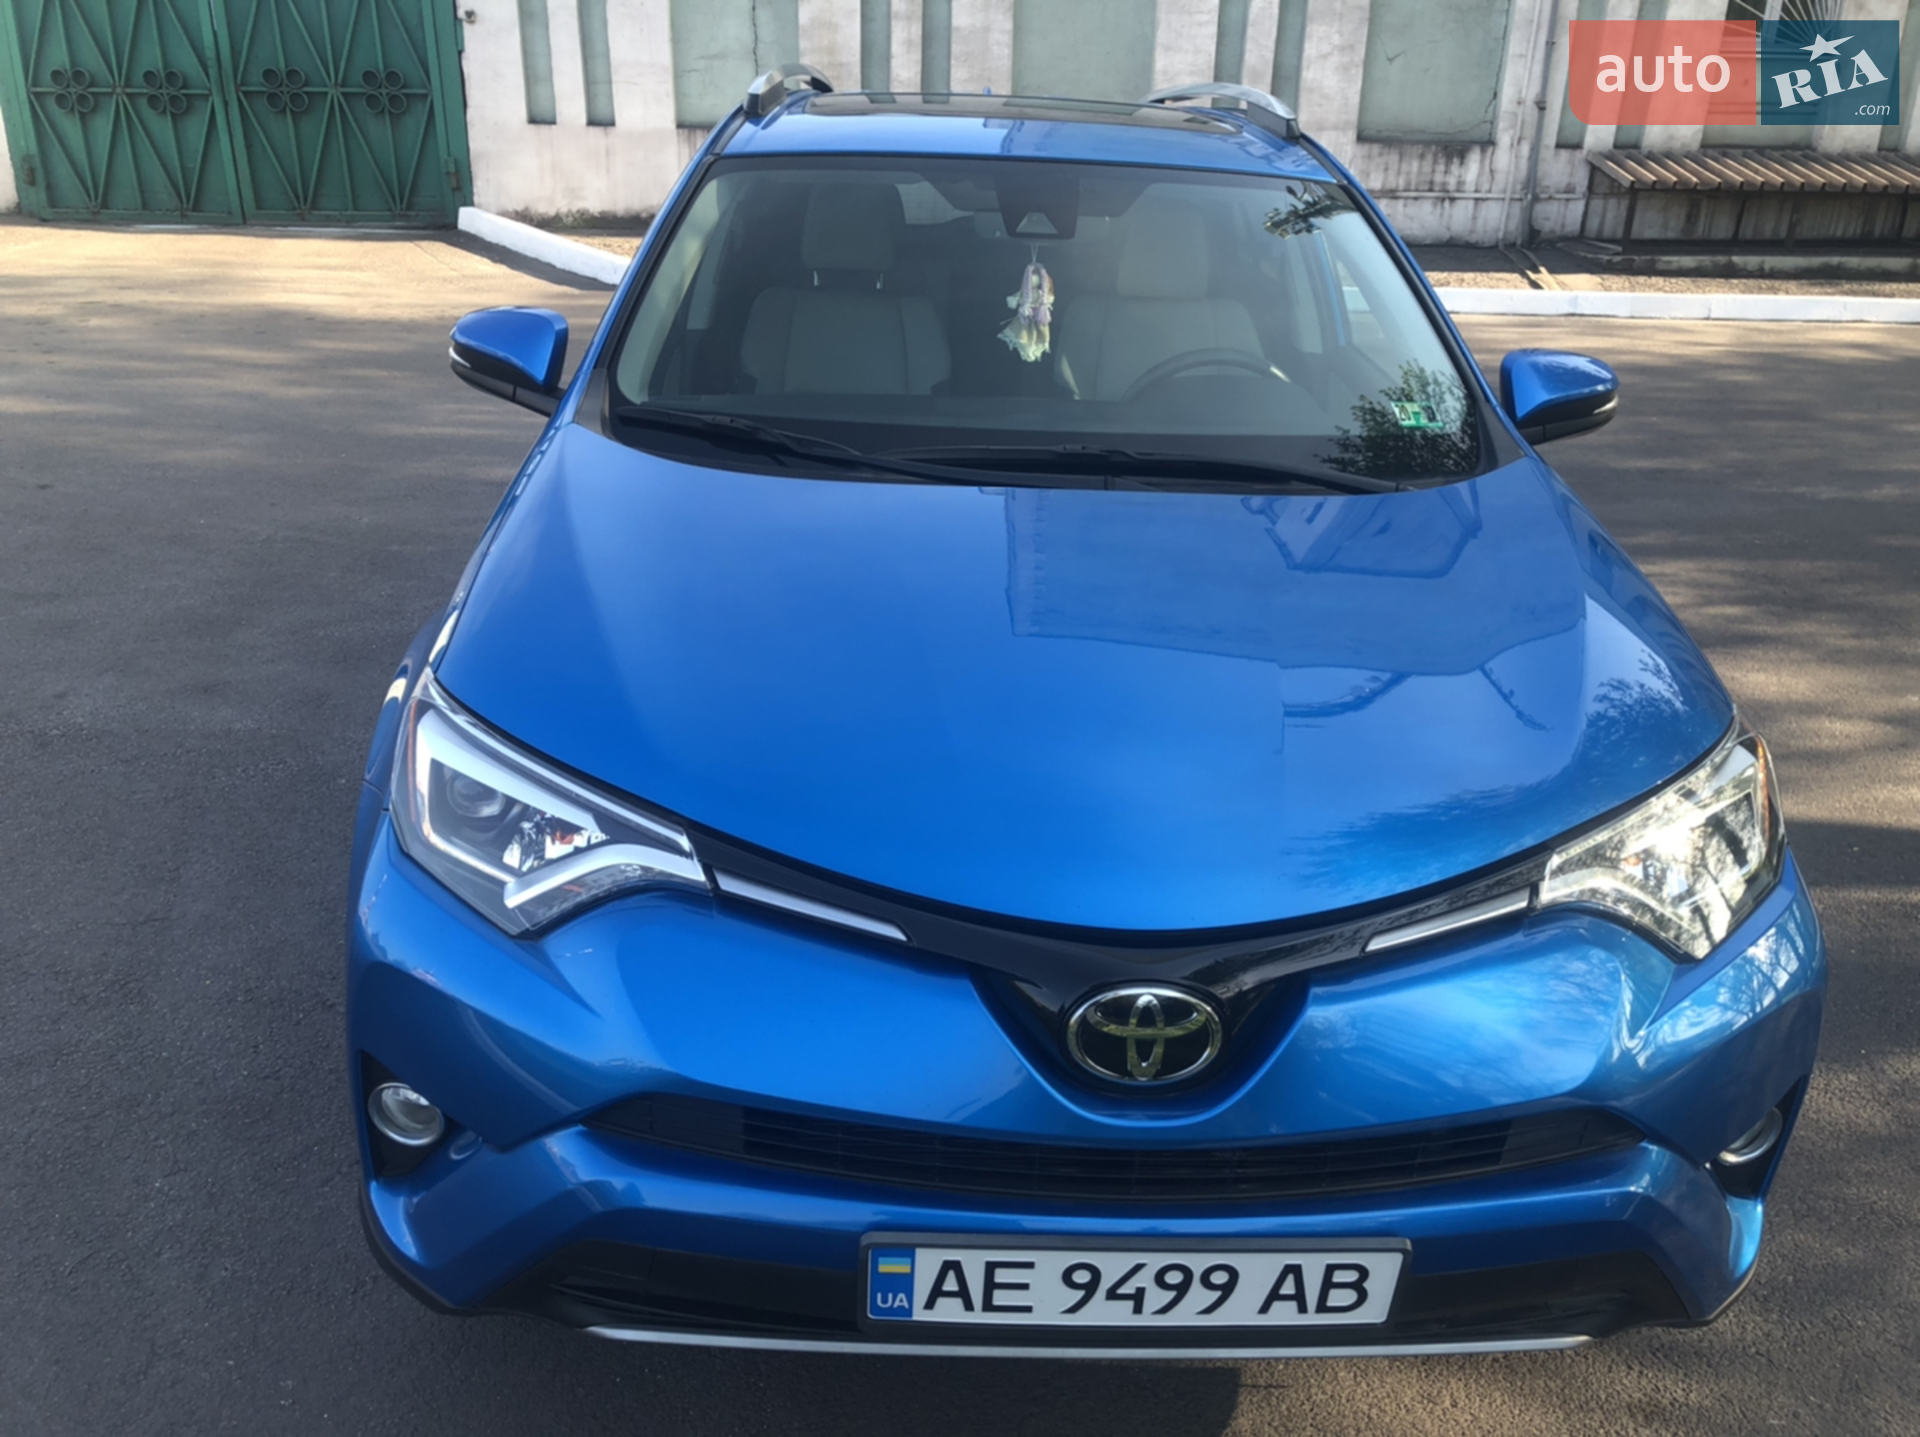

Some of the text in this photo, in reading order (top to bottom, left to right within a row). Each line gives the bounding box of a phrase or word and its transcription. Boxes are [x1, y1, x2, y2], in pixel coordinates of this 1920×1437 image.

[877, 1293, 909, 1309] UA
[922, 1259, 1370, 1314] AE 9499 AB
